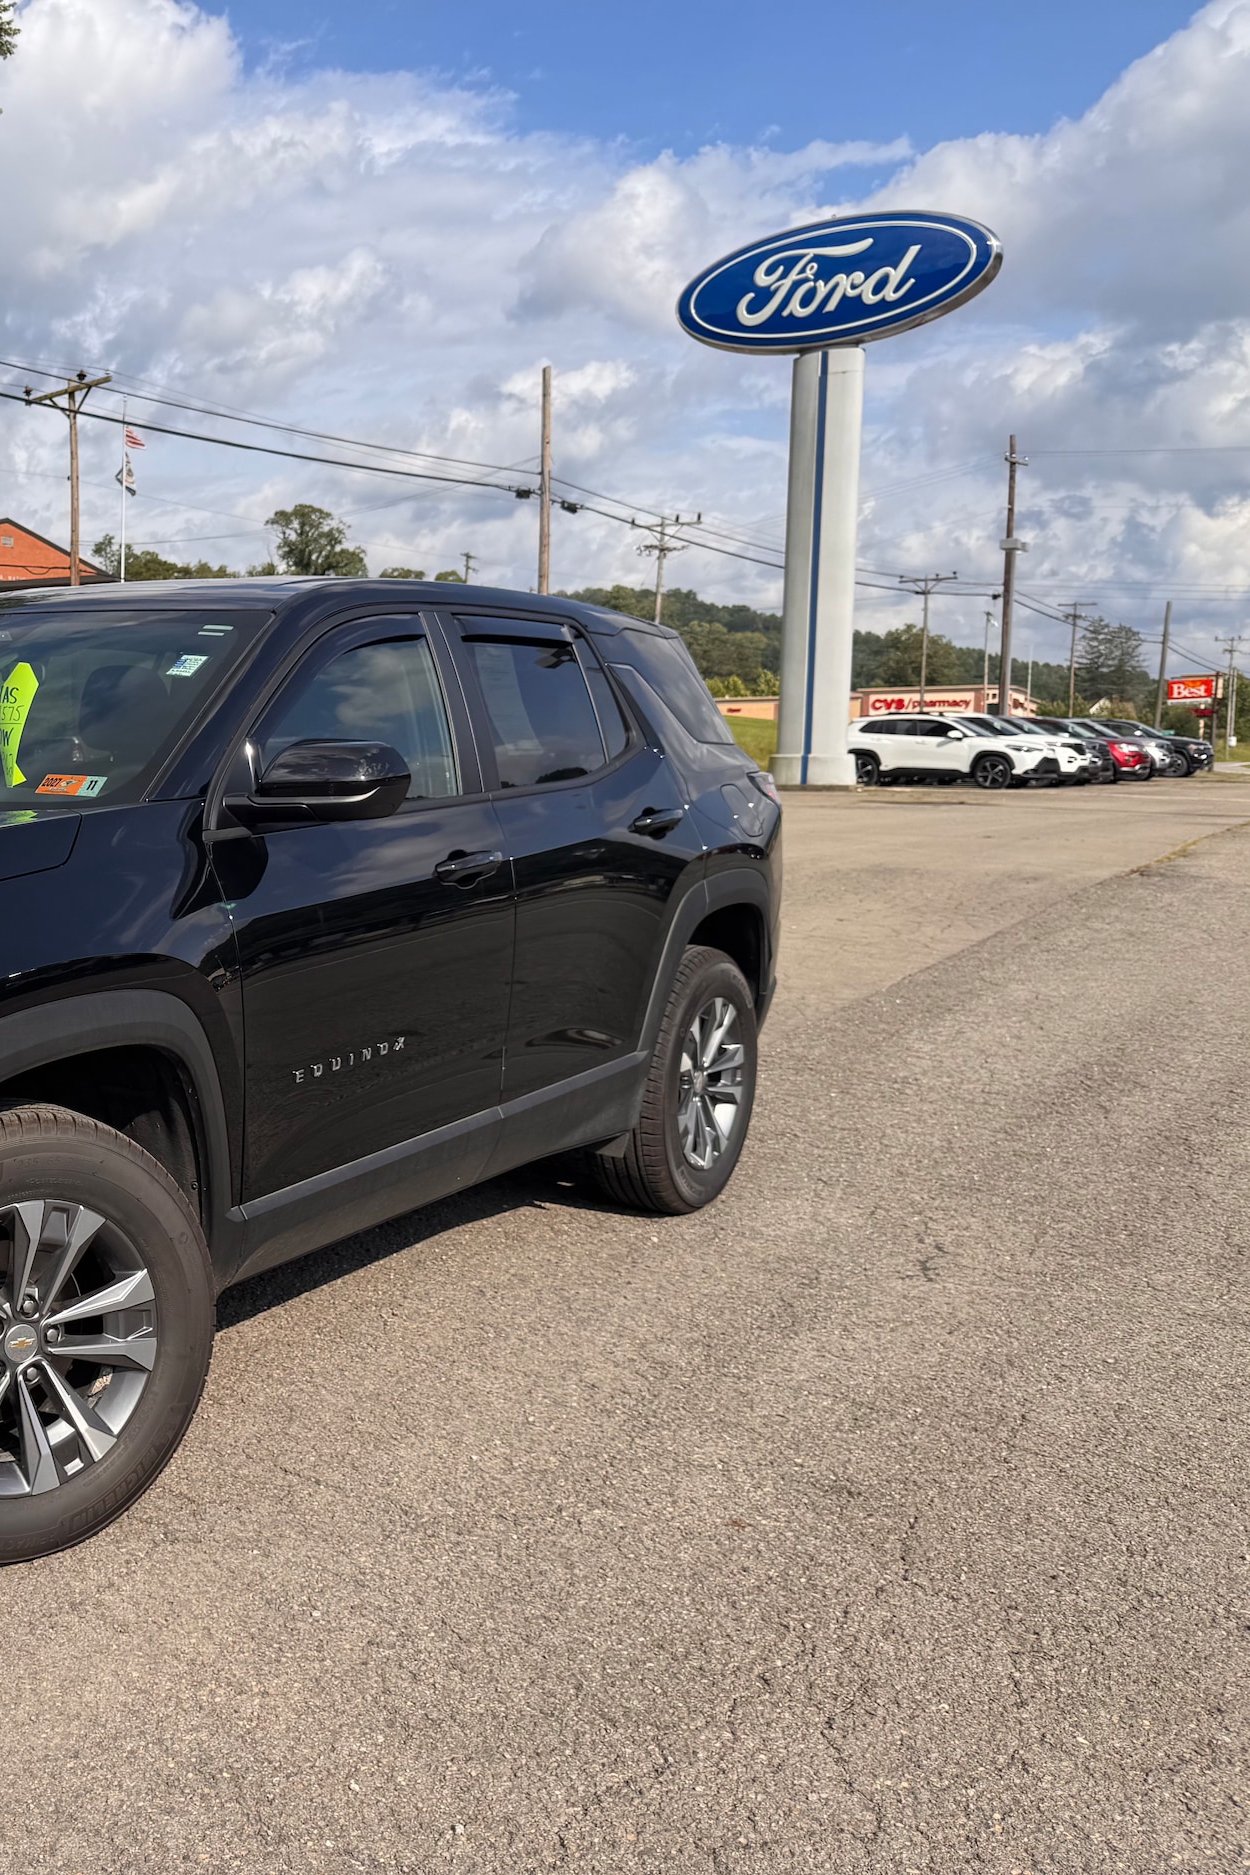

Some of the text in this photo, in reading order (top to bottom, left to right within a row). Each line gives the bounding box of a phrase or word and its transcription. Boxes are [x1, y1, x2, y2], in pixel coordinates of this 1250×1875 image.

[735, 236, 922, 327] Ford
[1172, 683, 1208, 698] Best
[41, 777, 99, 791] 2027 11
[291, 1036, 406, 1084] EQUINOX
[67, 1446, 159, 1532] MICHELIN
